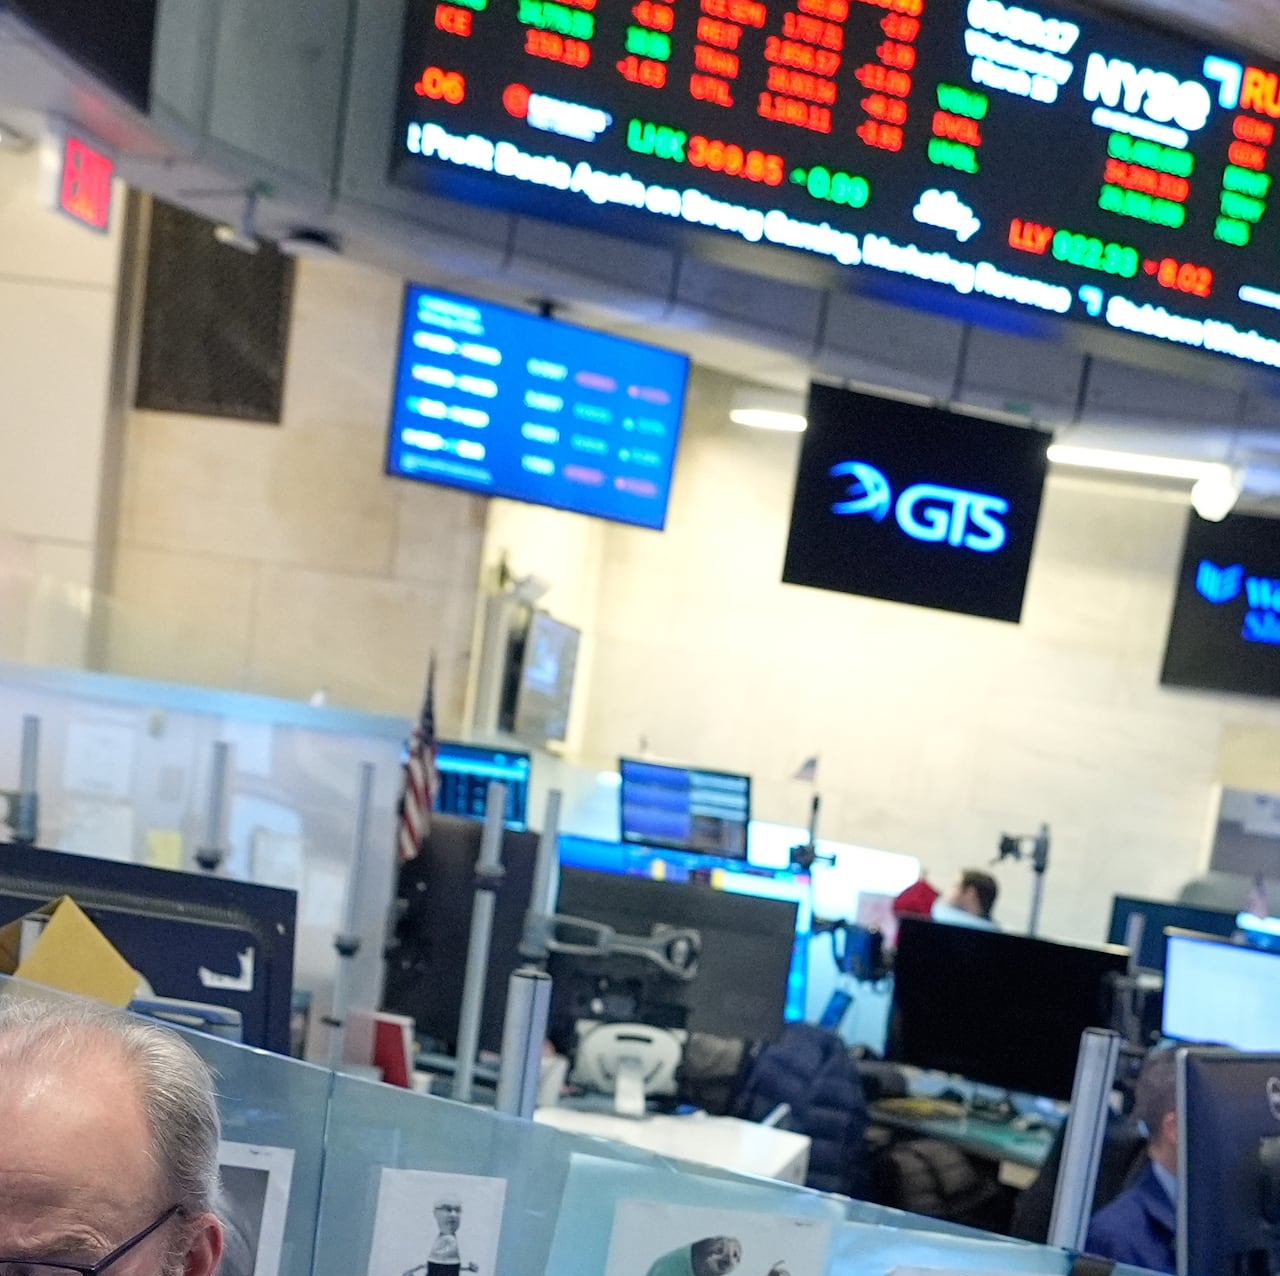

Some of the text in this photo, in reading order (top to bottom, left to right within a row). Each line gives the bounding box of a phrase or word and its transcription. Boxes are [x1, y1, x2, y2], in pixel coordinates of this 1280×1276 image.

[571, 162, 645, 208] Again
[645, 186, 681, 217] on
[681, 189, 764, 242] Strong
[975, 262, 1072, 313] Revenue
[896, 483, 1010, 553] GTS
